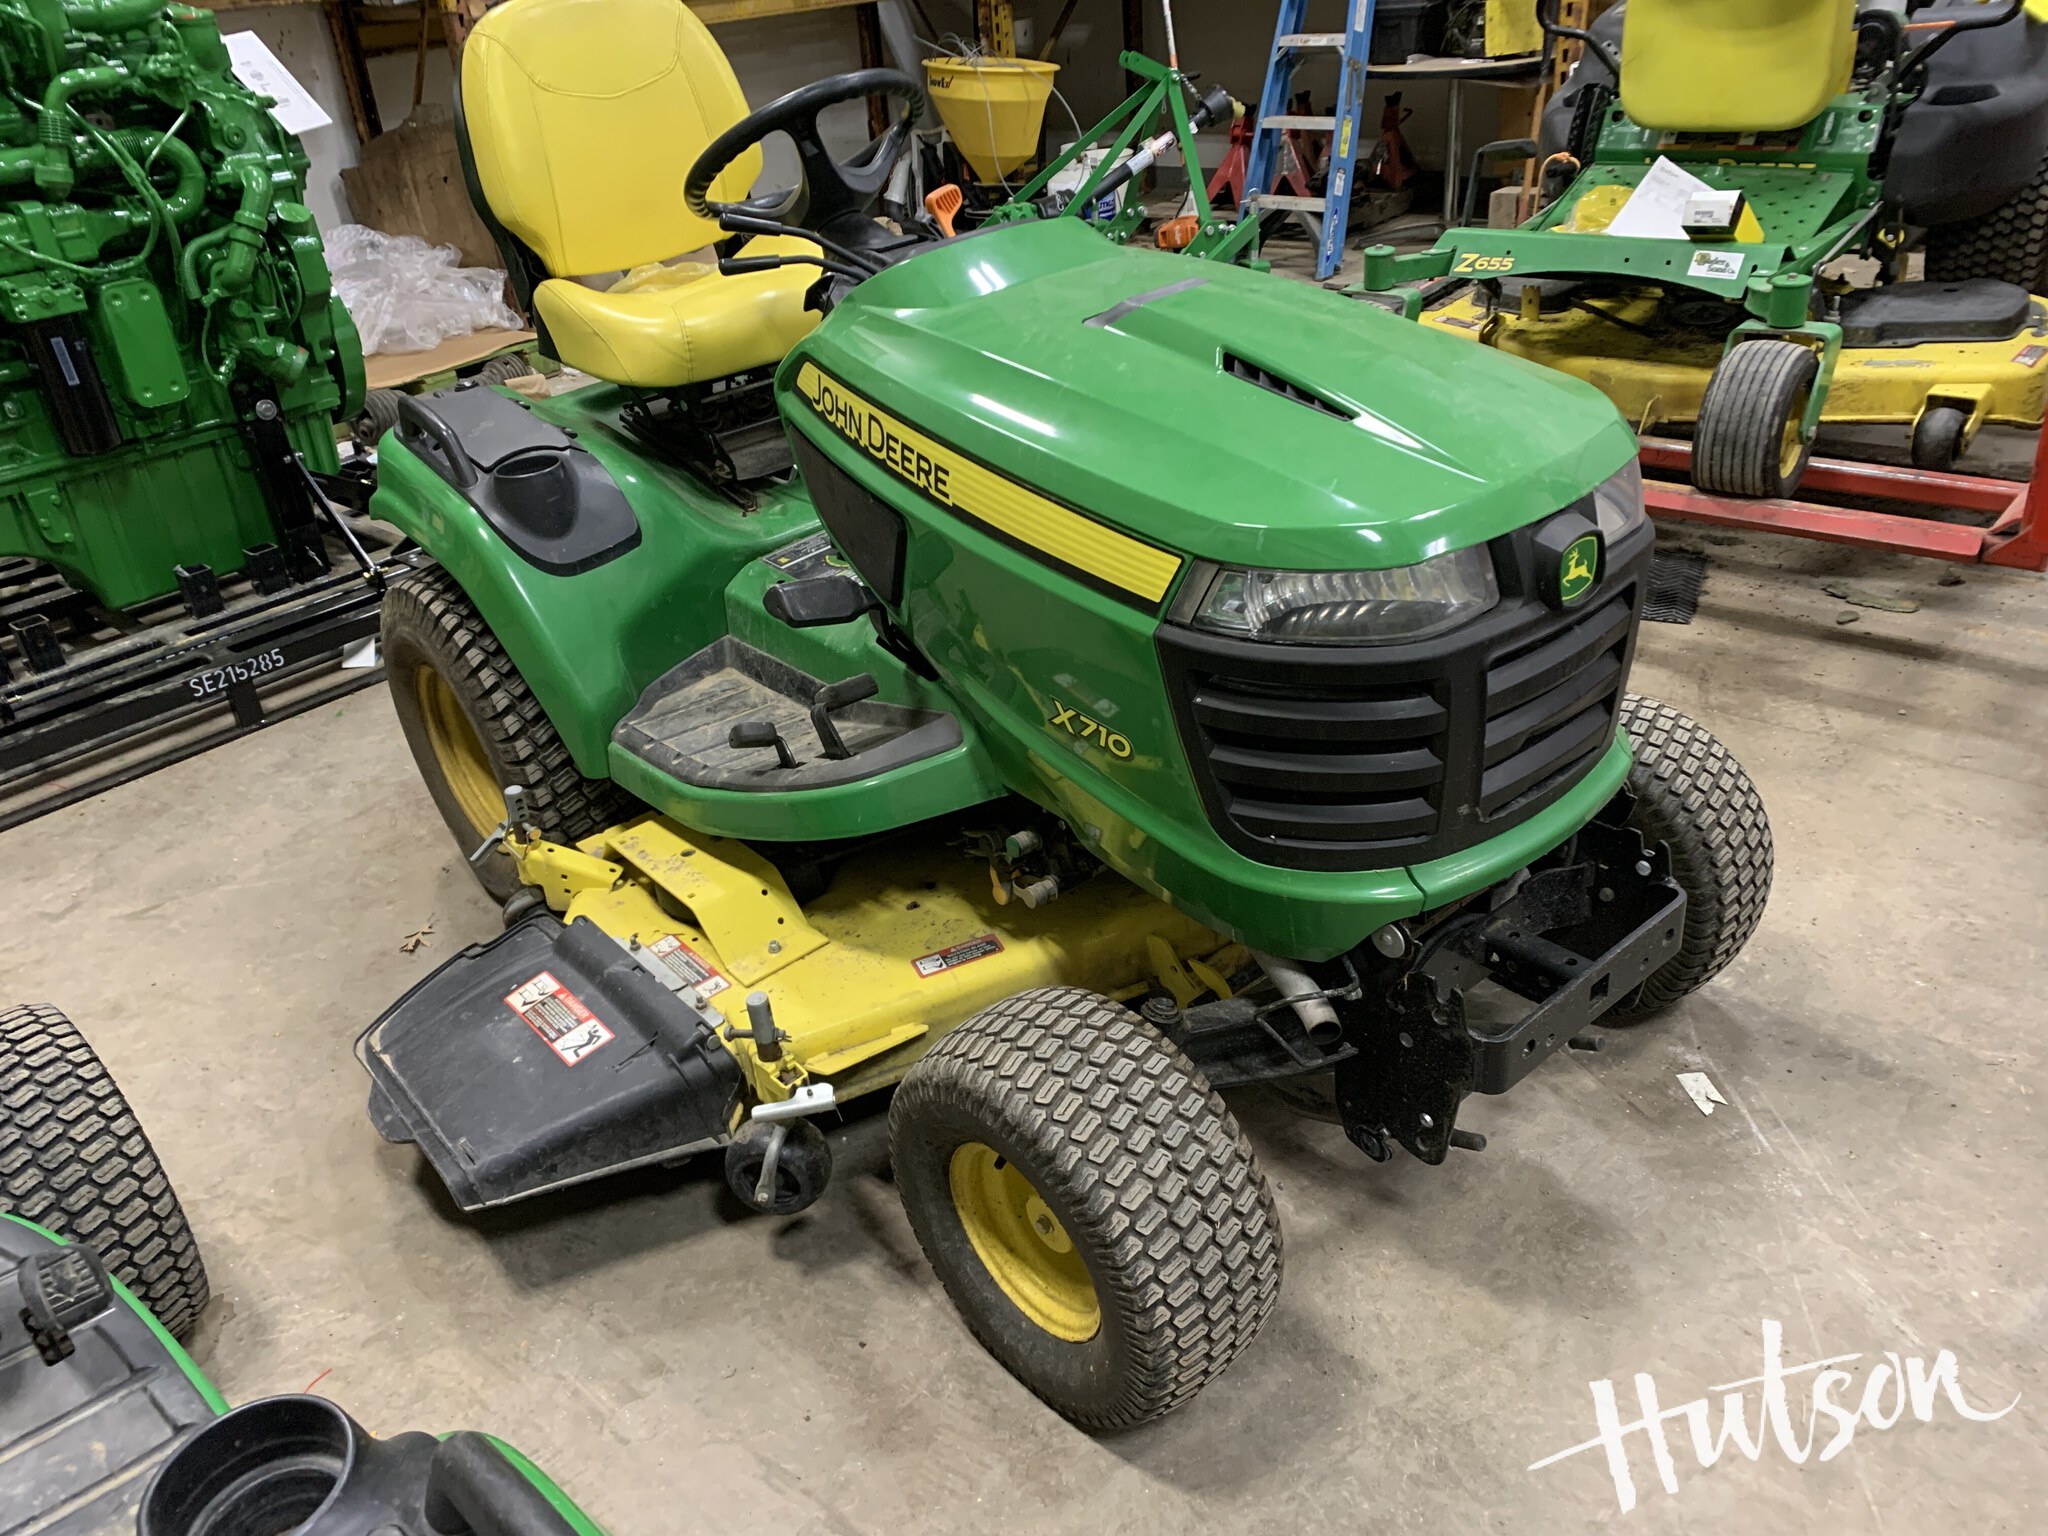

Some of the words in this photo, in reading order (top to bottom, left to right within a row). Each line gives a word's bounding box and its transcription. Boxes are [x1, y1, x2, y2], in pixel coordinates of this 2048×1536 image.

[1453, 252, 1515, 273] Z655
[812, 374, 862, 440] JOHN
[868, 412, 950, 500] DEERE
[189, 648, 285, 697] SE215285
[1051, 700, 1131, 757] X710
